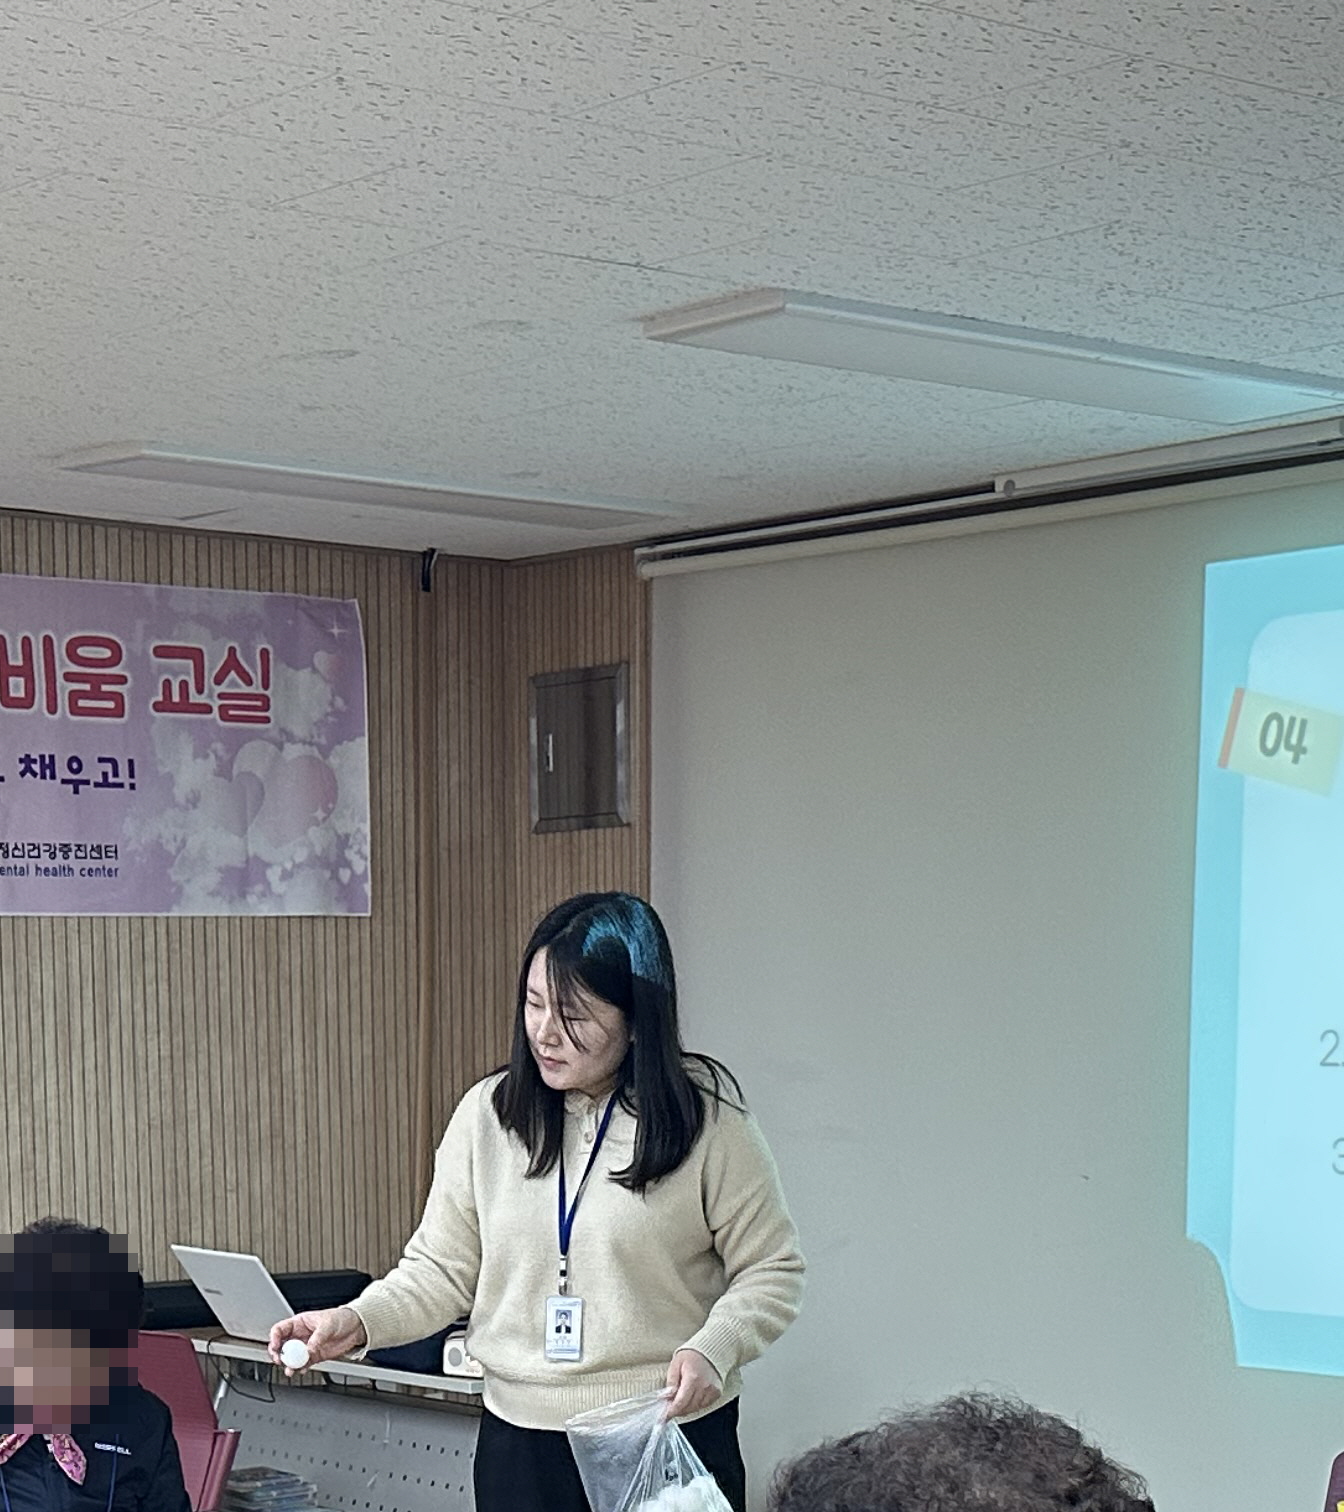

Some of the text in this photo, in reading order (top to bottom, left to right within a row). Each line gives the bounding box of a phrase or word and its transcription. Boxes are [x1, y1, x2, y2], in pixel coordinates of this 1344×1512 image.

[151, 644, 272, 725] 교실
[1258, 711, 1309, 765] 04
[17, 753, 137, 796] 채우고!
[34, 863, 75, 878] health
[79, 865, 119, 879] center
